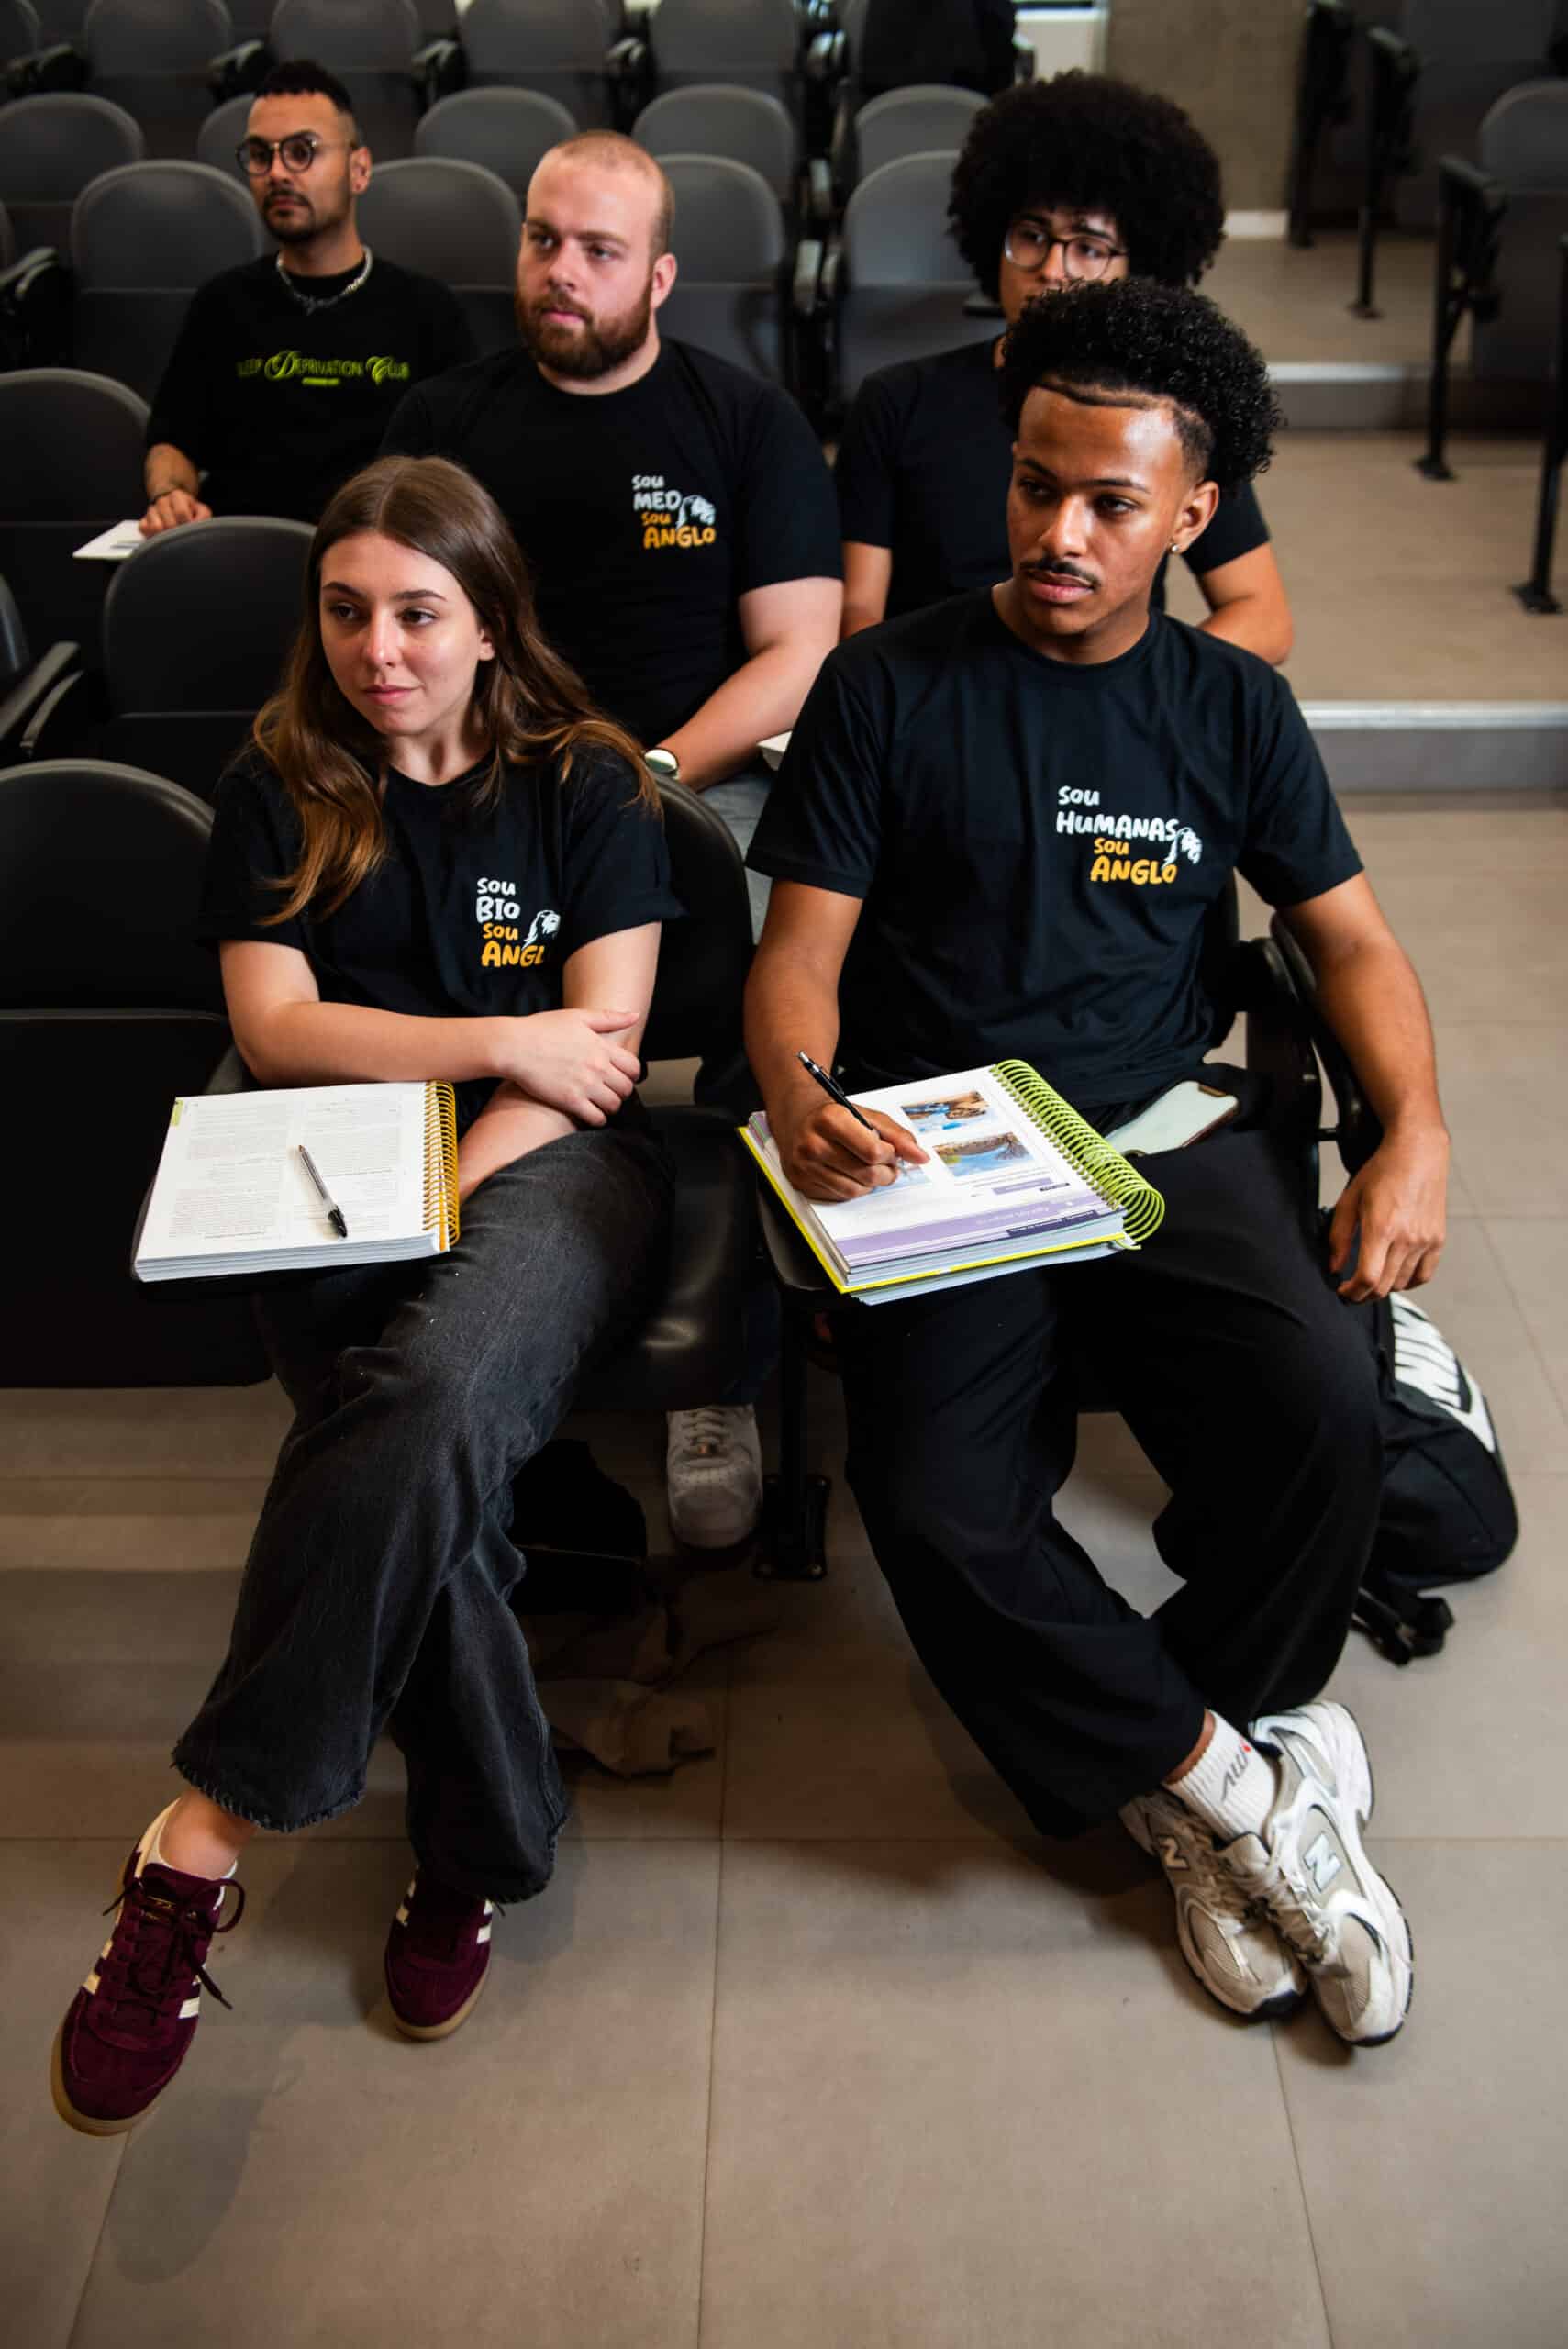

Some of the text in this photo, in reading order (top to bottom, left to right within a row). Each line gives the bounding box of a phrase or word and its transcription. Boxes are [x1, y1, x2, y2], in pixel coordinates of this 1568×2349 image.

[631, 474, 664, 491] SOU
[633, 489, 682, 511] MED
[641, 511, 671, 526] SOU
[643, 525, 716, 550] ANGLO
[1057, 785, 1100, 806] SOU
[1056, 810, 1180, 842] HUMANAS
[1094, 837, 1129, 855] SOU
[1090, 854, 1178, 885] ANGLO
[477, 877, 516, 896] SOU
[475, 895, 521, 924] BIO
[483, 922, 518, 941] SOU
